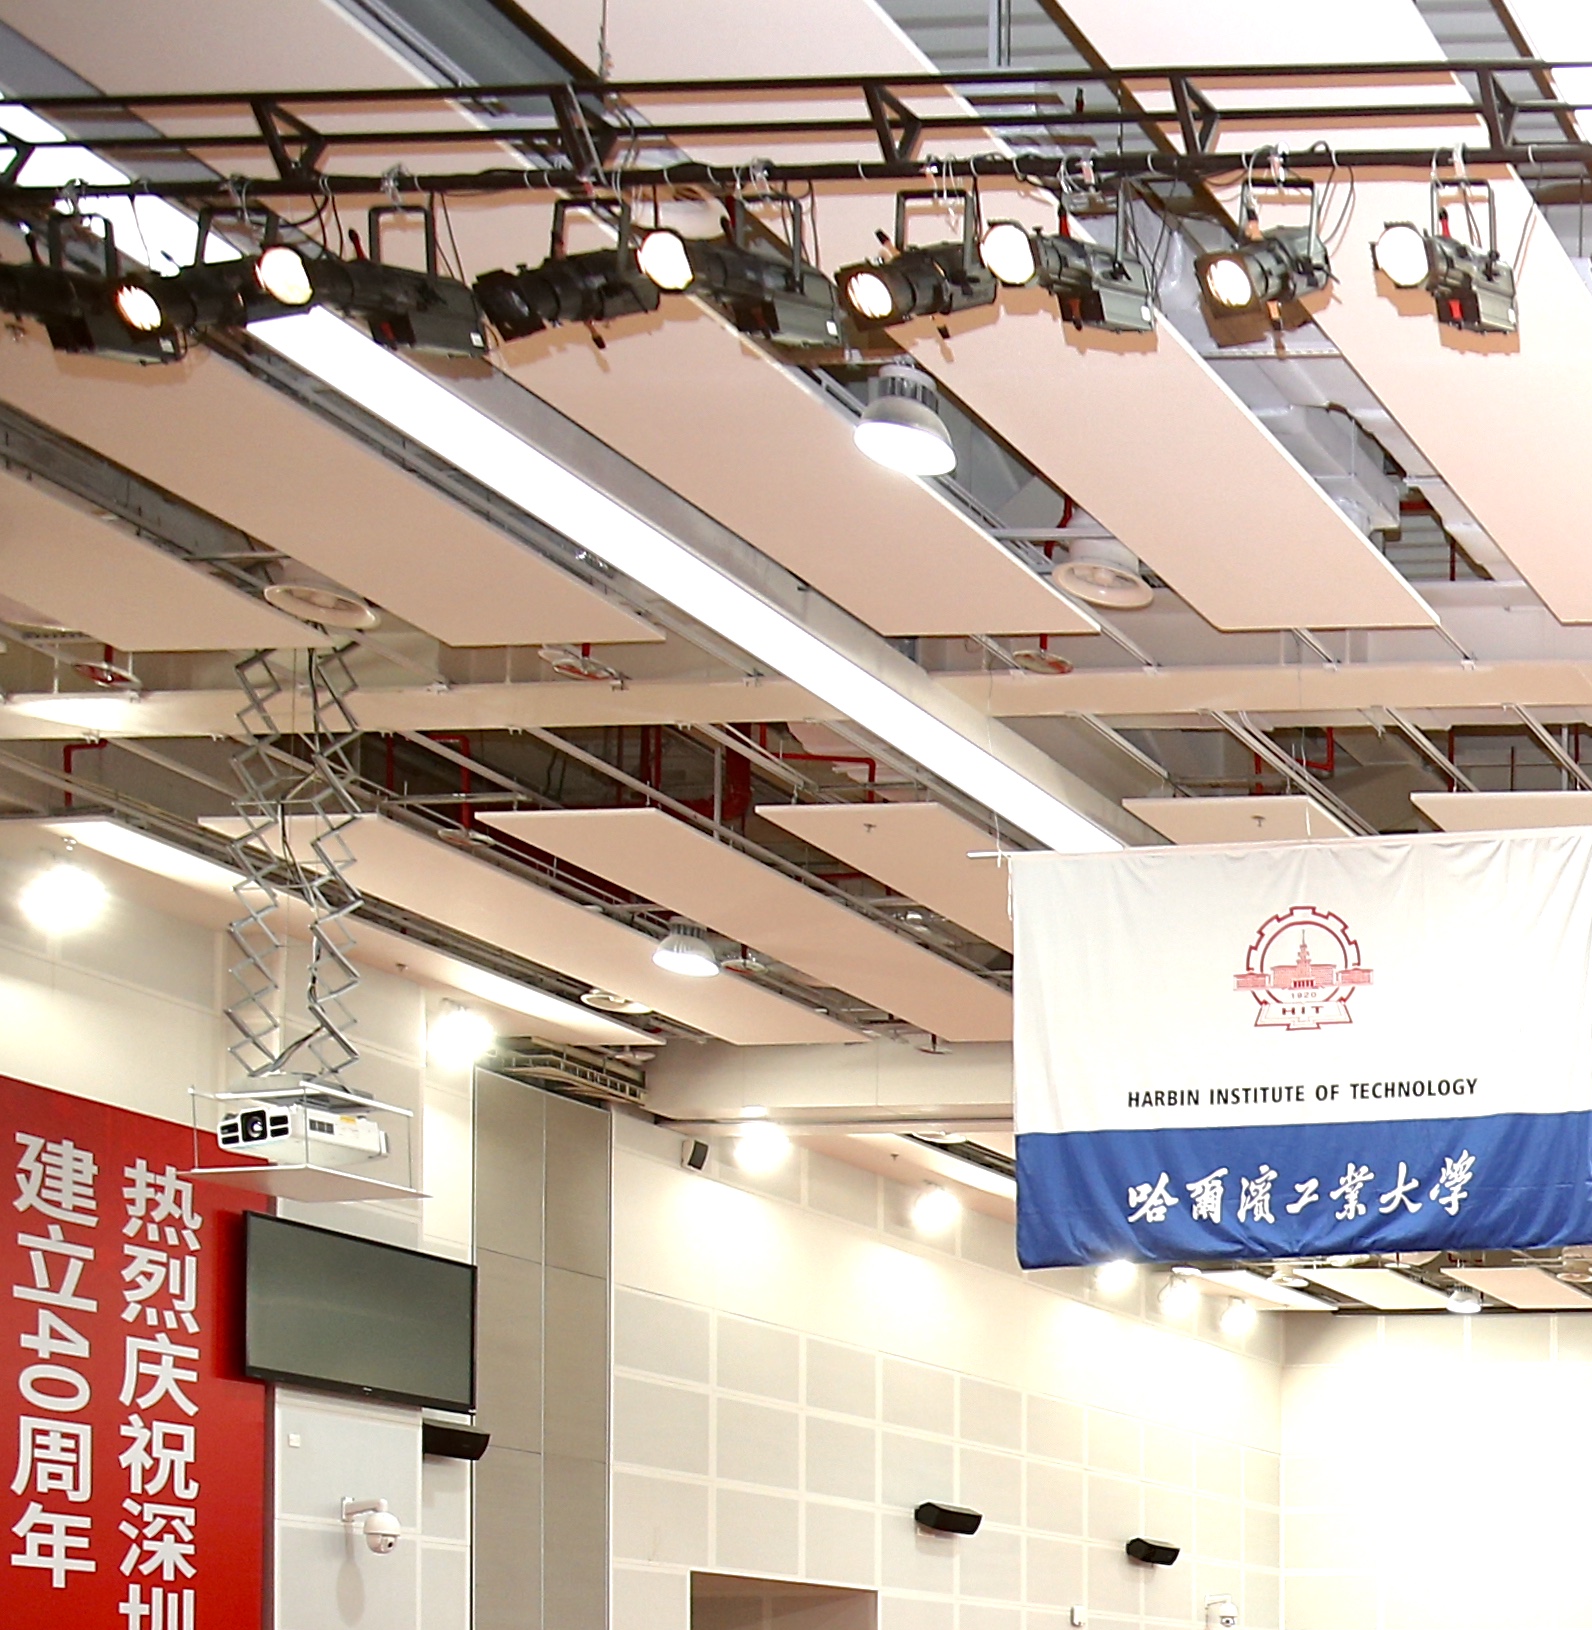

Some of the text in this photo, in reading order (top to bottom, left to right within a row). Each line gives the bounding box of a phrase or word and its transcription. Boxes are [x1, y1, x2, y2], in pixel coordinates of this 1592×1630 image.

[1281, 1005, 1325, 1016] HIT
[1127, 1077, 1478, 1108] HARBIN INSTITUTE OF TECHNOLOGY
[10, 1131, 99, 1589] 建立40周年
